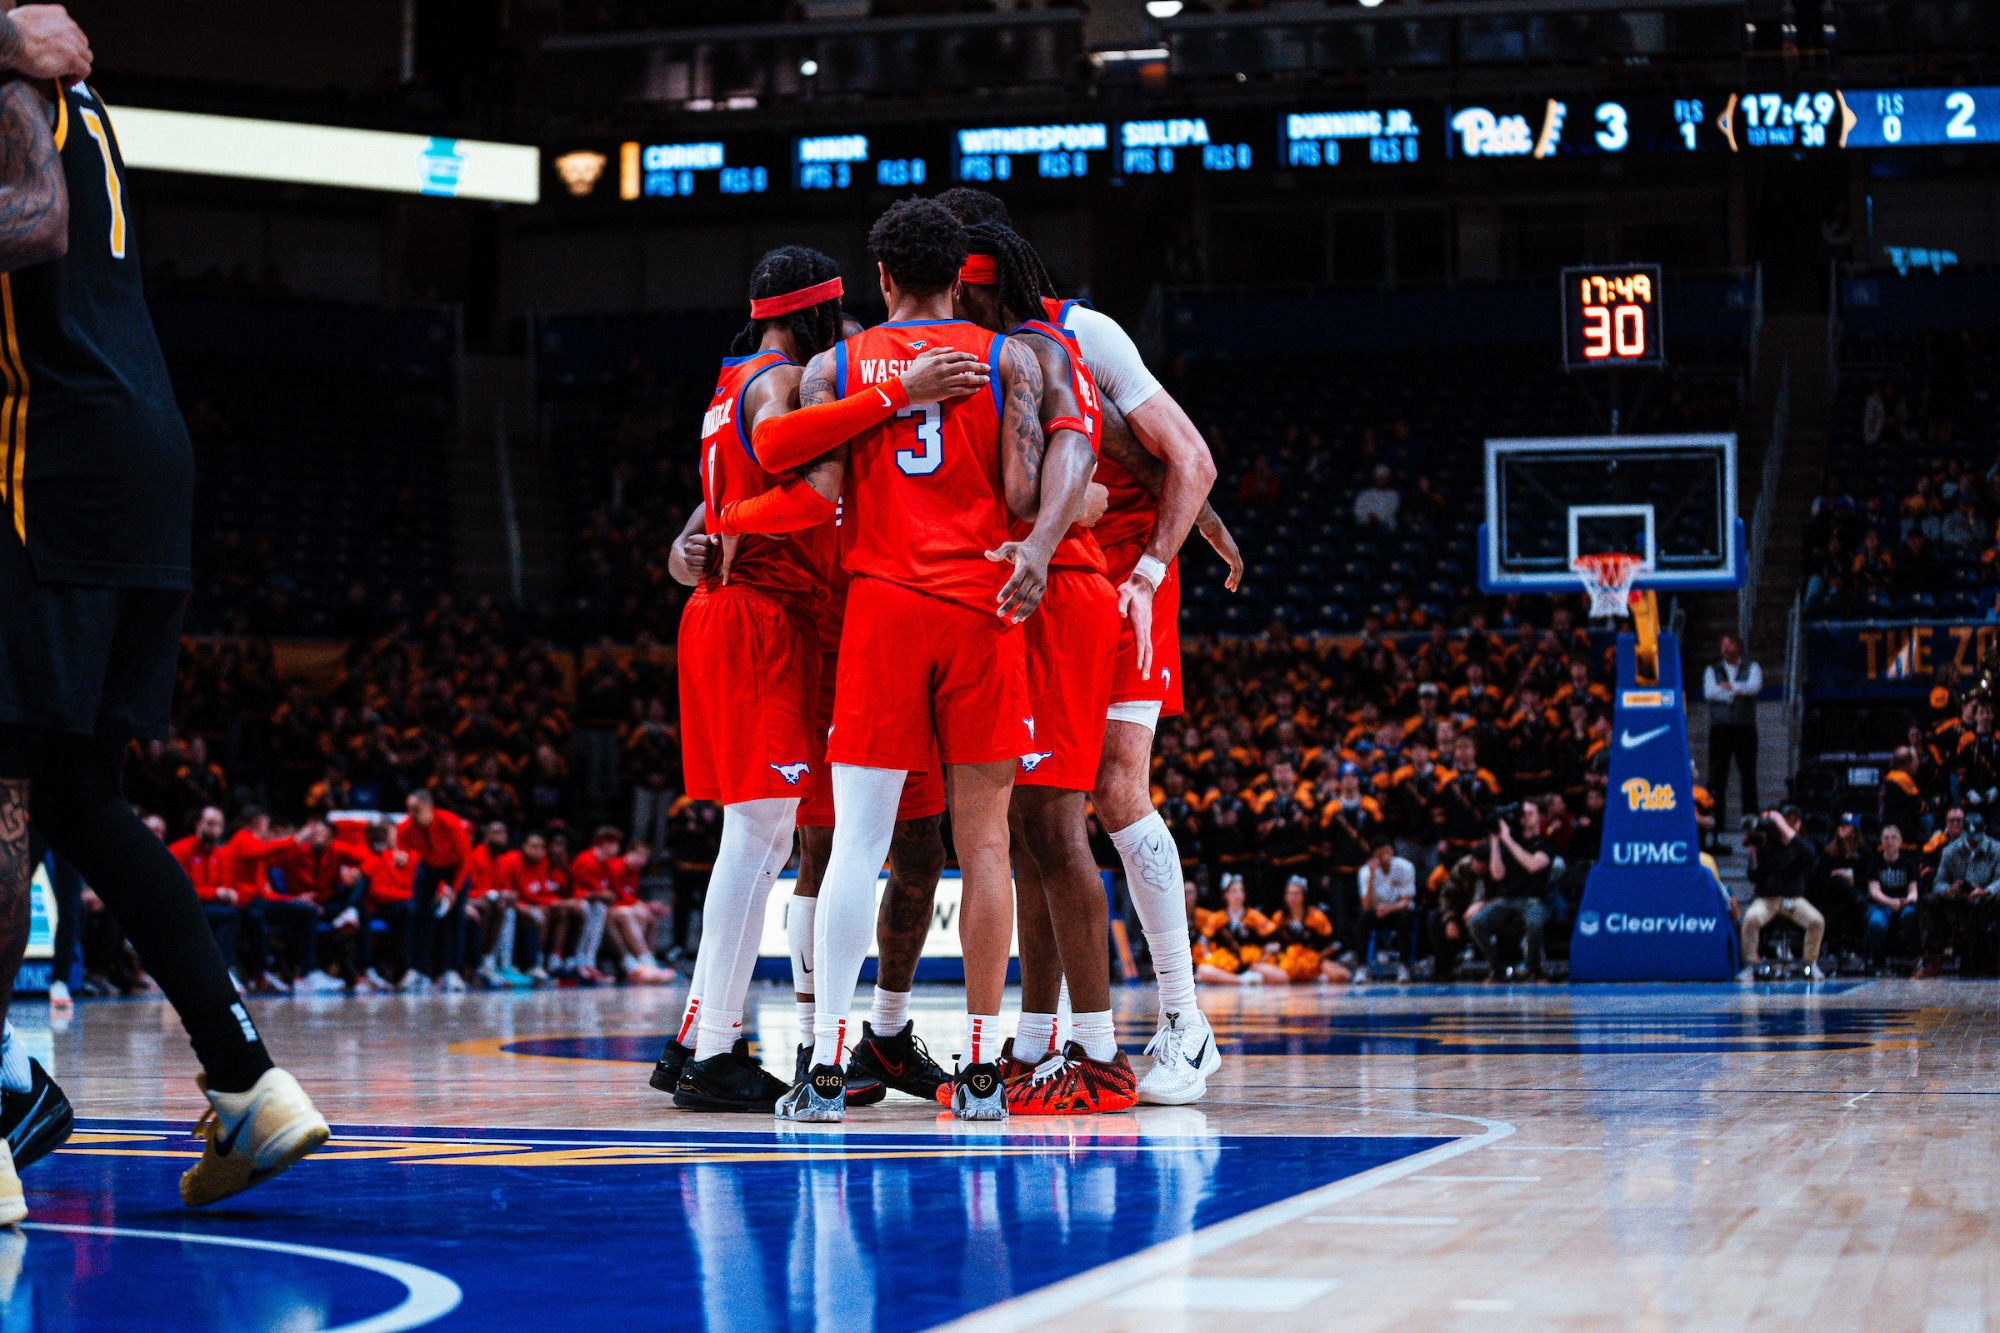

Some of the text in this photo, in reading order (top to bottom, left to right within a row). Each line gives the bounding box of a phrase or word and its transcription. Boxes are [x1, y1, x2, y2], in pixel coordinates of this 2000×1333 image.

[1741, 92, 1836, 127] 17:49
[1876, 92, 1904, 116] FLS
[1945, 91, 1976, 138] 2
[958, 123, 1107, 154] WITHERSPOON
[1287, 110, 1382, 139] DUNNING
[1451, 107, 1533, 156] Pitt
[1595, 102, 1629, 151] 3
[1680, 120, 1697, 150] 1
[1801, 122, 1826, 147] 30
[1882, 115, 1902, 142] 0
[1581, 273, 1652, 305] 17:49
[1582, 304, 1645, 359] 30
[895, 402, 944, 476] 3
[1858, 627, 1934, 680] THE
[1621, 777, 1676, 811] Pitt
[1612, 841, 1688, 865] UPMC
[1605, 912, 1716, 933] Clearview
[815, 1075, 843, 1088] GiGi
